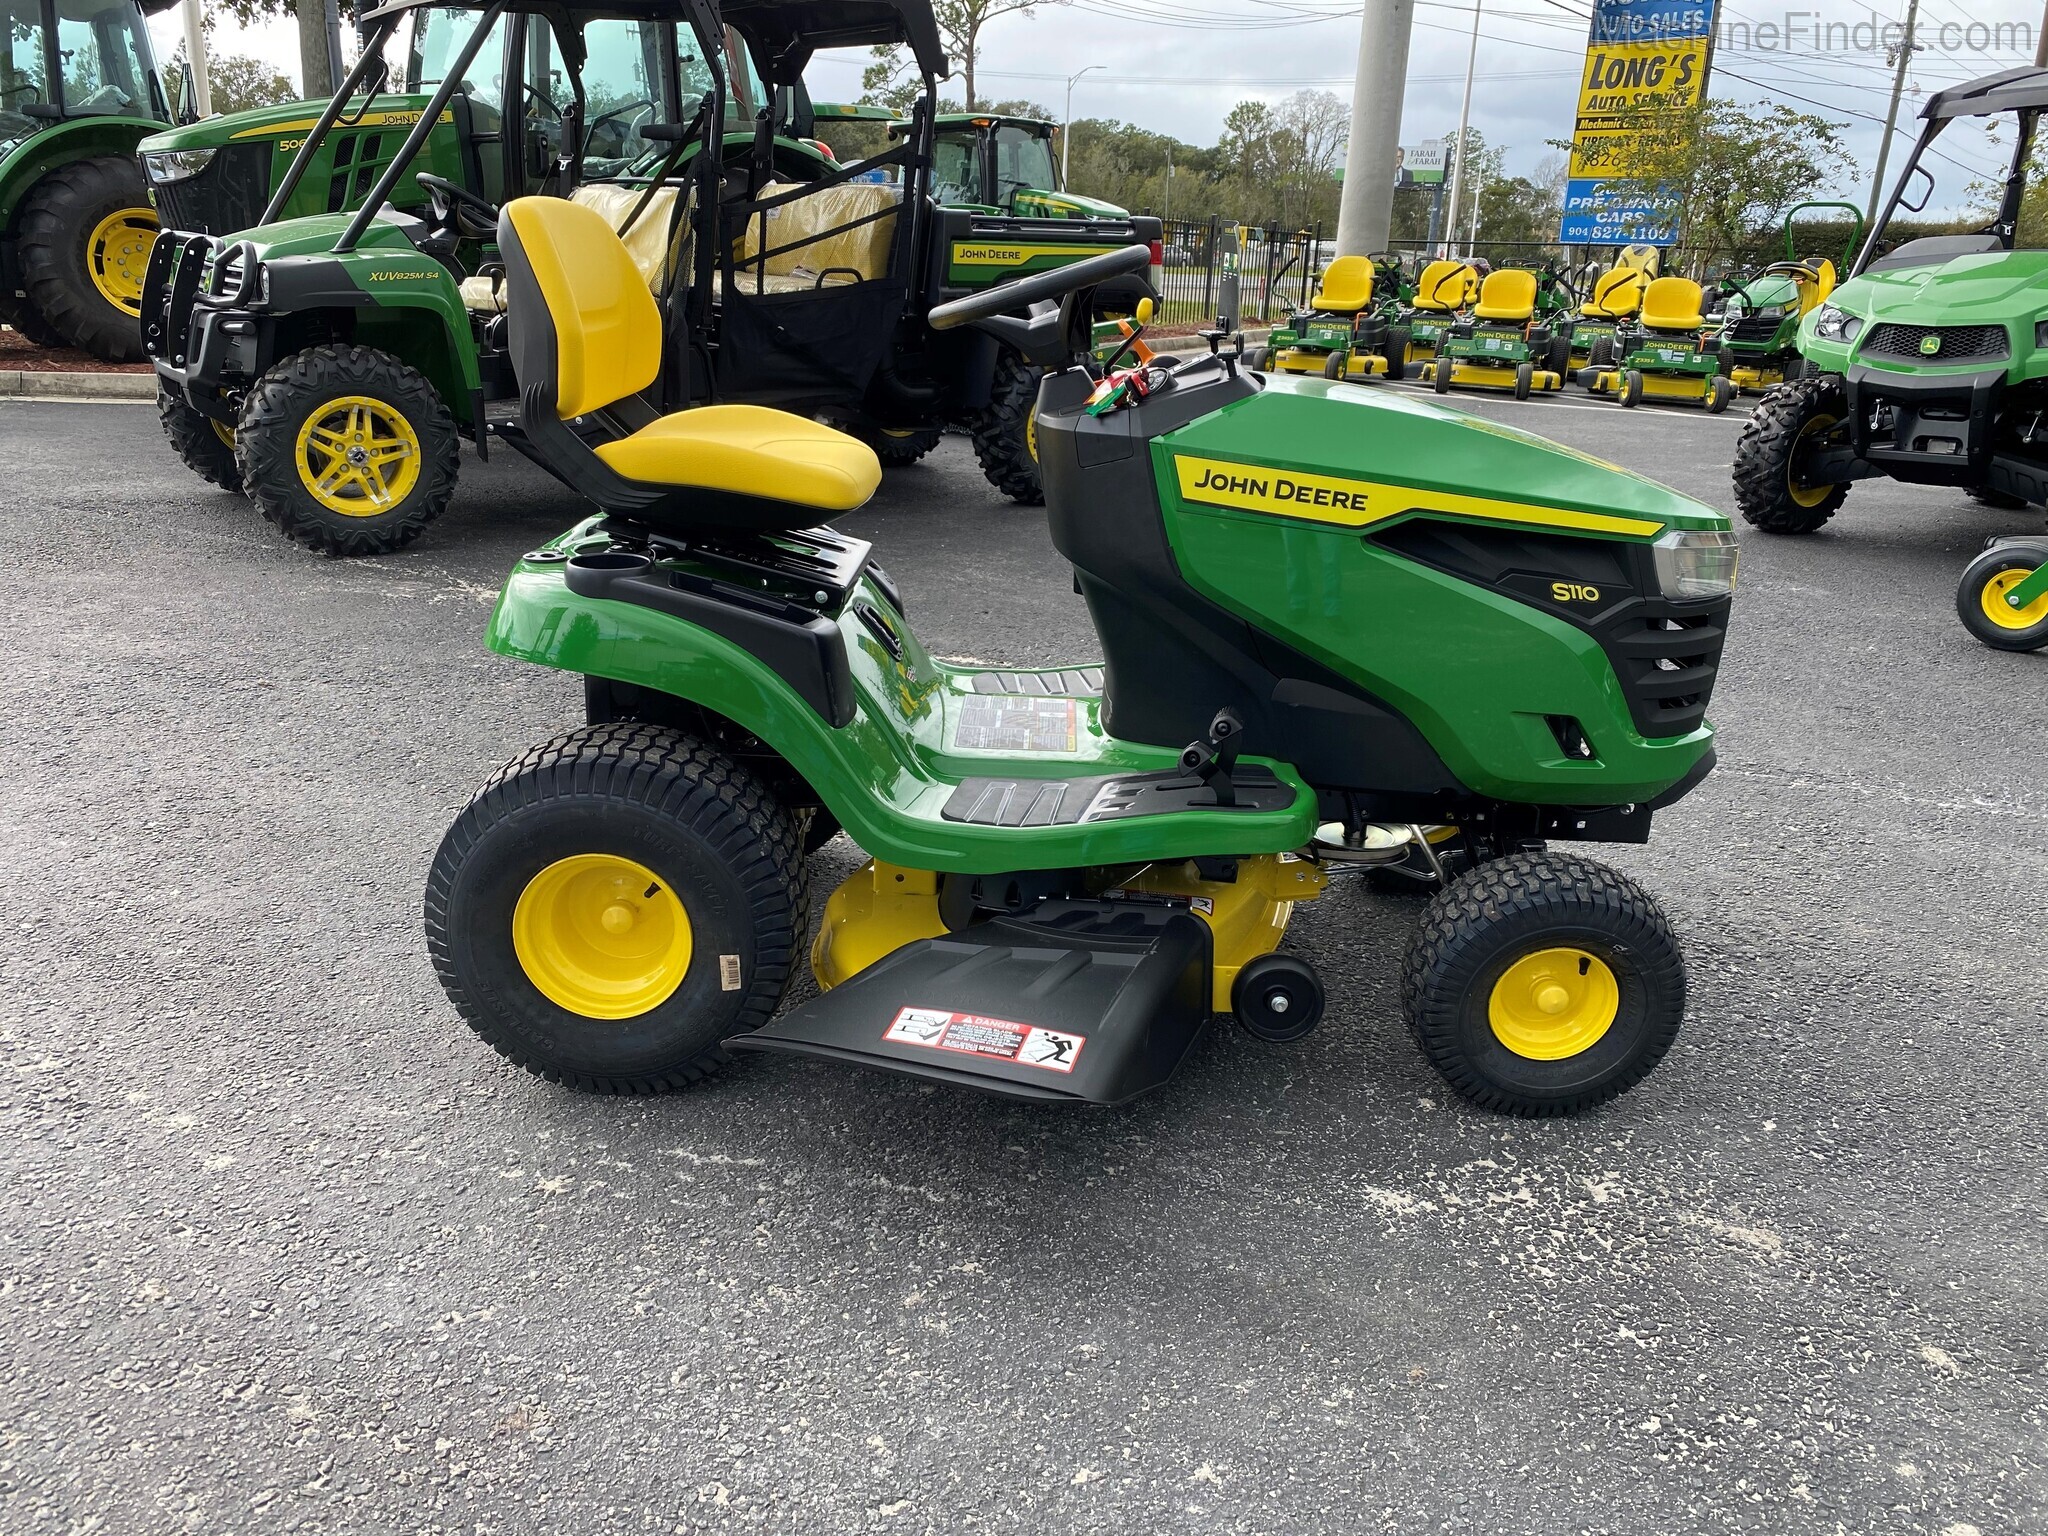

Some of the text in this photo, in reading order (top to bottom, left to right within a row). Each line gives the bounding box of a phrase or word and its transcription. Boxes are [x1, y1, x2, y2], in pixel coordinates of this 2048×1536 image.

[1598, 9, 1705, 35] AUTO SALES
[1588, 53, 1697, 90] LONG'S
[1586, 91, 1689, 110] AUTO SEICE
[382, 114, 410, 125] JOHN
[1579, 118, 1621, 130] Mechanic
[279, 137, 326, 151] 506E
[1410, 150, 1437, 158] FARAH
[1415, 158, 1441, 166] FARAH
[1595, 211, 1645, 223] CARS
[1568, 226, 1588, 236] 904
[960, 248, 1021, 260] JOHN DEERE
[368, 271, 439, 281] XUV825M S4
[1308, 322, 1351, 331] JOHN DEERE
[1575, 326, 1615, 335] JOHN DEERE
[1474, 331, 1521, 340] JOHN DEERE
[1644, 341, 1695, 351] JOHN DEERE
[1194, 468, 1369, 511] JOHN DEERE
[1551, 582, 1600, 602] S110
[974, 1017, 1021, 1032] DANGER
